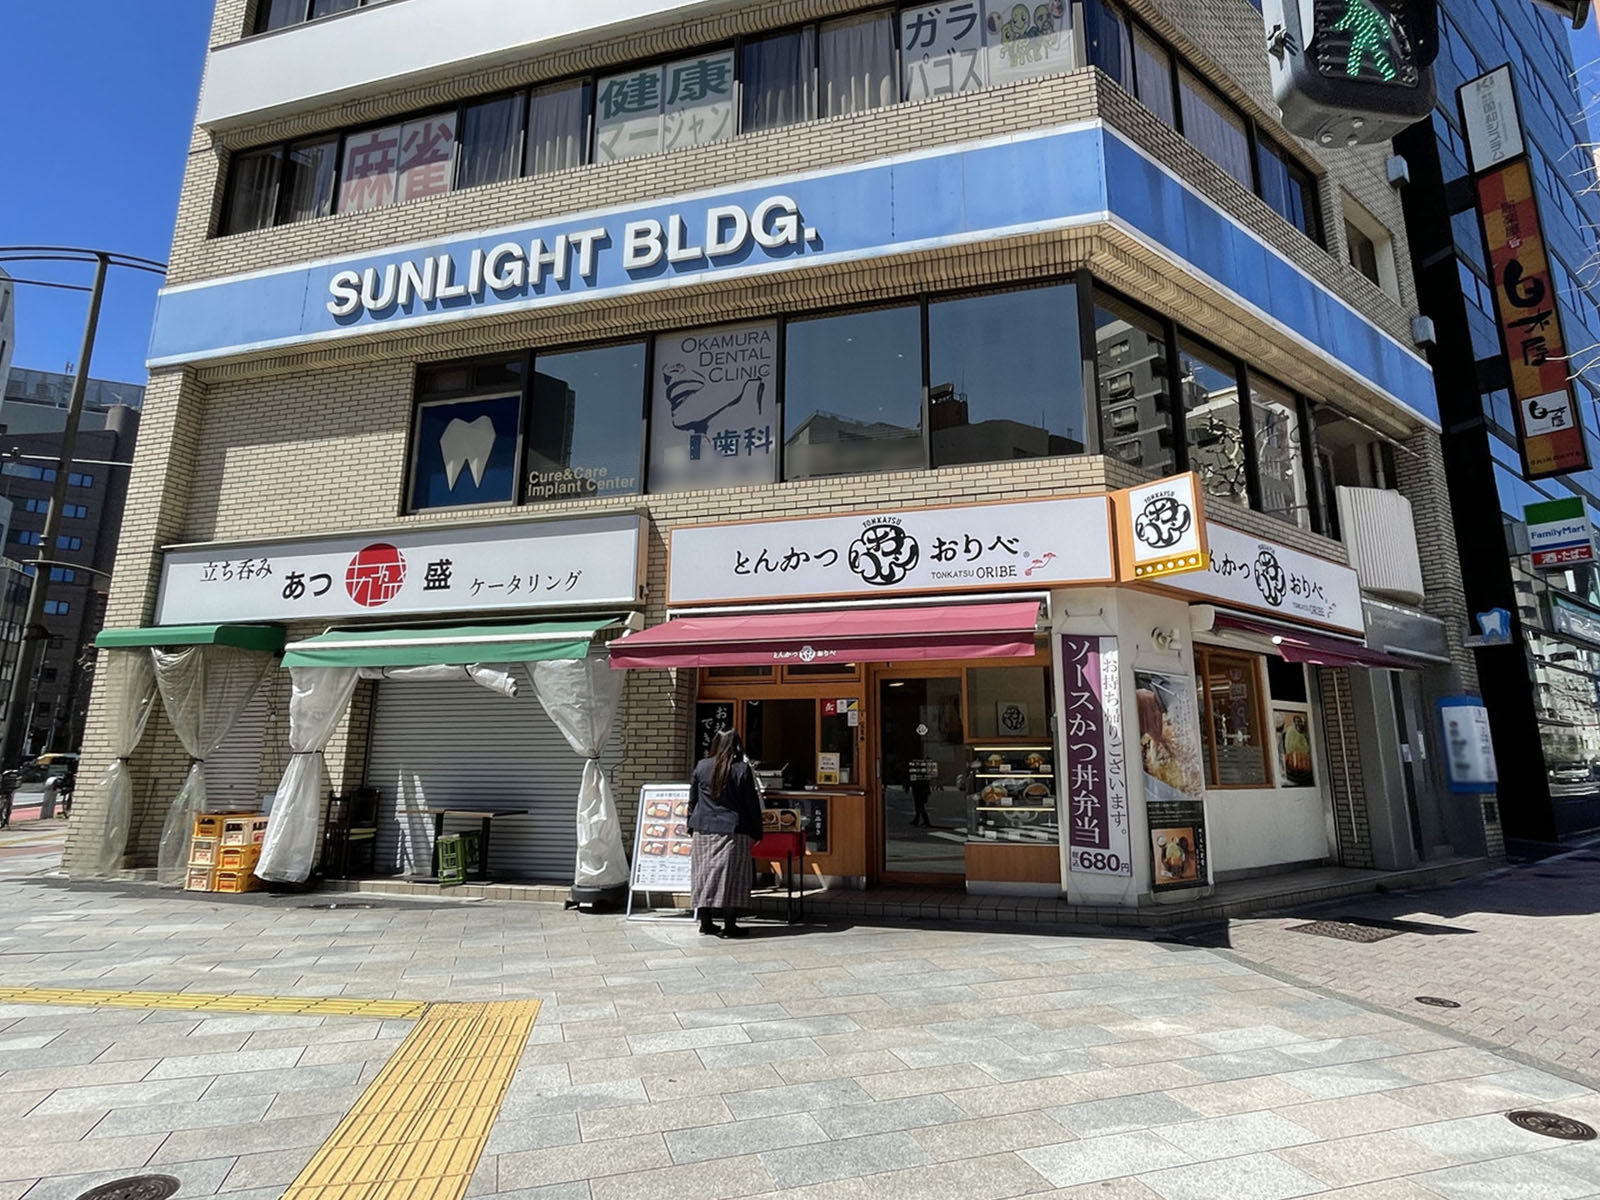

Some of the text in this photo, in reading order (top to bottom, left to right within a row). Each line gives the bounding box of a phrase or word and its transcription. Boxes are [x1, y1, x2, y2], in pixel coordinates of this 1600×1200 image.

[598, 57, 732, 121] 健康
[597, 102, 733, 161] マージャン
[338, 122, 454, 211] 麻雀
[326, 195, 818, 317] SUNLIGHT BLDG.
[681, 330, 771, 353] OKAMURA
[699, 347, 771, 367] DENTAL
[709, 364, 771, 383] CLINIC
[712, 425, 773, 457] 歯科
[528, 477, 635, 498] Implant Center
[529, 467, 608, 484] Cure&Care
[862, 516, 902, 529] TONKATSU
[1531, 524, 1587, 540] FamilyMart
[733, 547, 839, 575] とんかつ
[930, 534, 1020, 562] おりべ
[200, 558, 272, 582] 立ち呑み
[423, 558, 452, 591] 盛
[470, 570, 582, 597] ケータリング
[931, 565, 1017, 579] TONKATSU ORIBE
[1067, 640, 1101, 844] ソースかつ丼弁当
